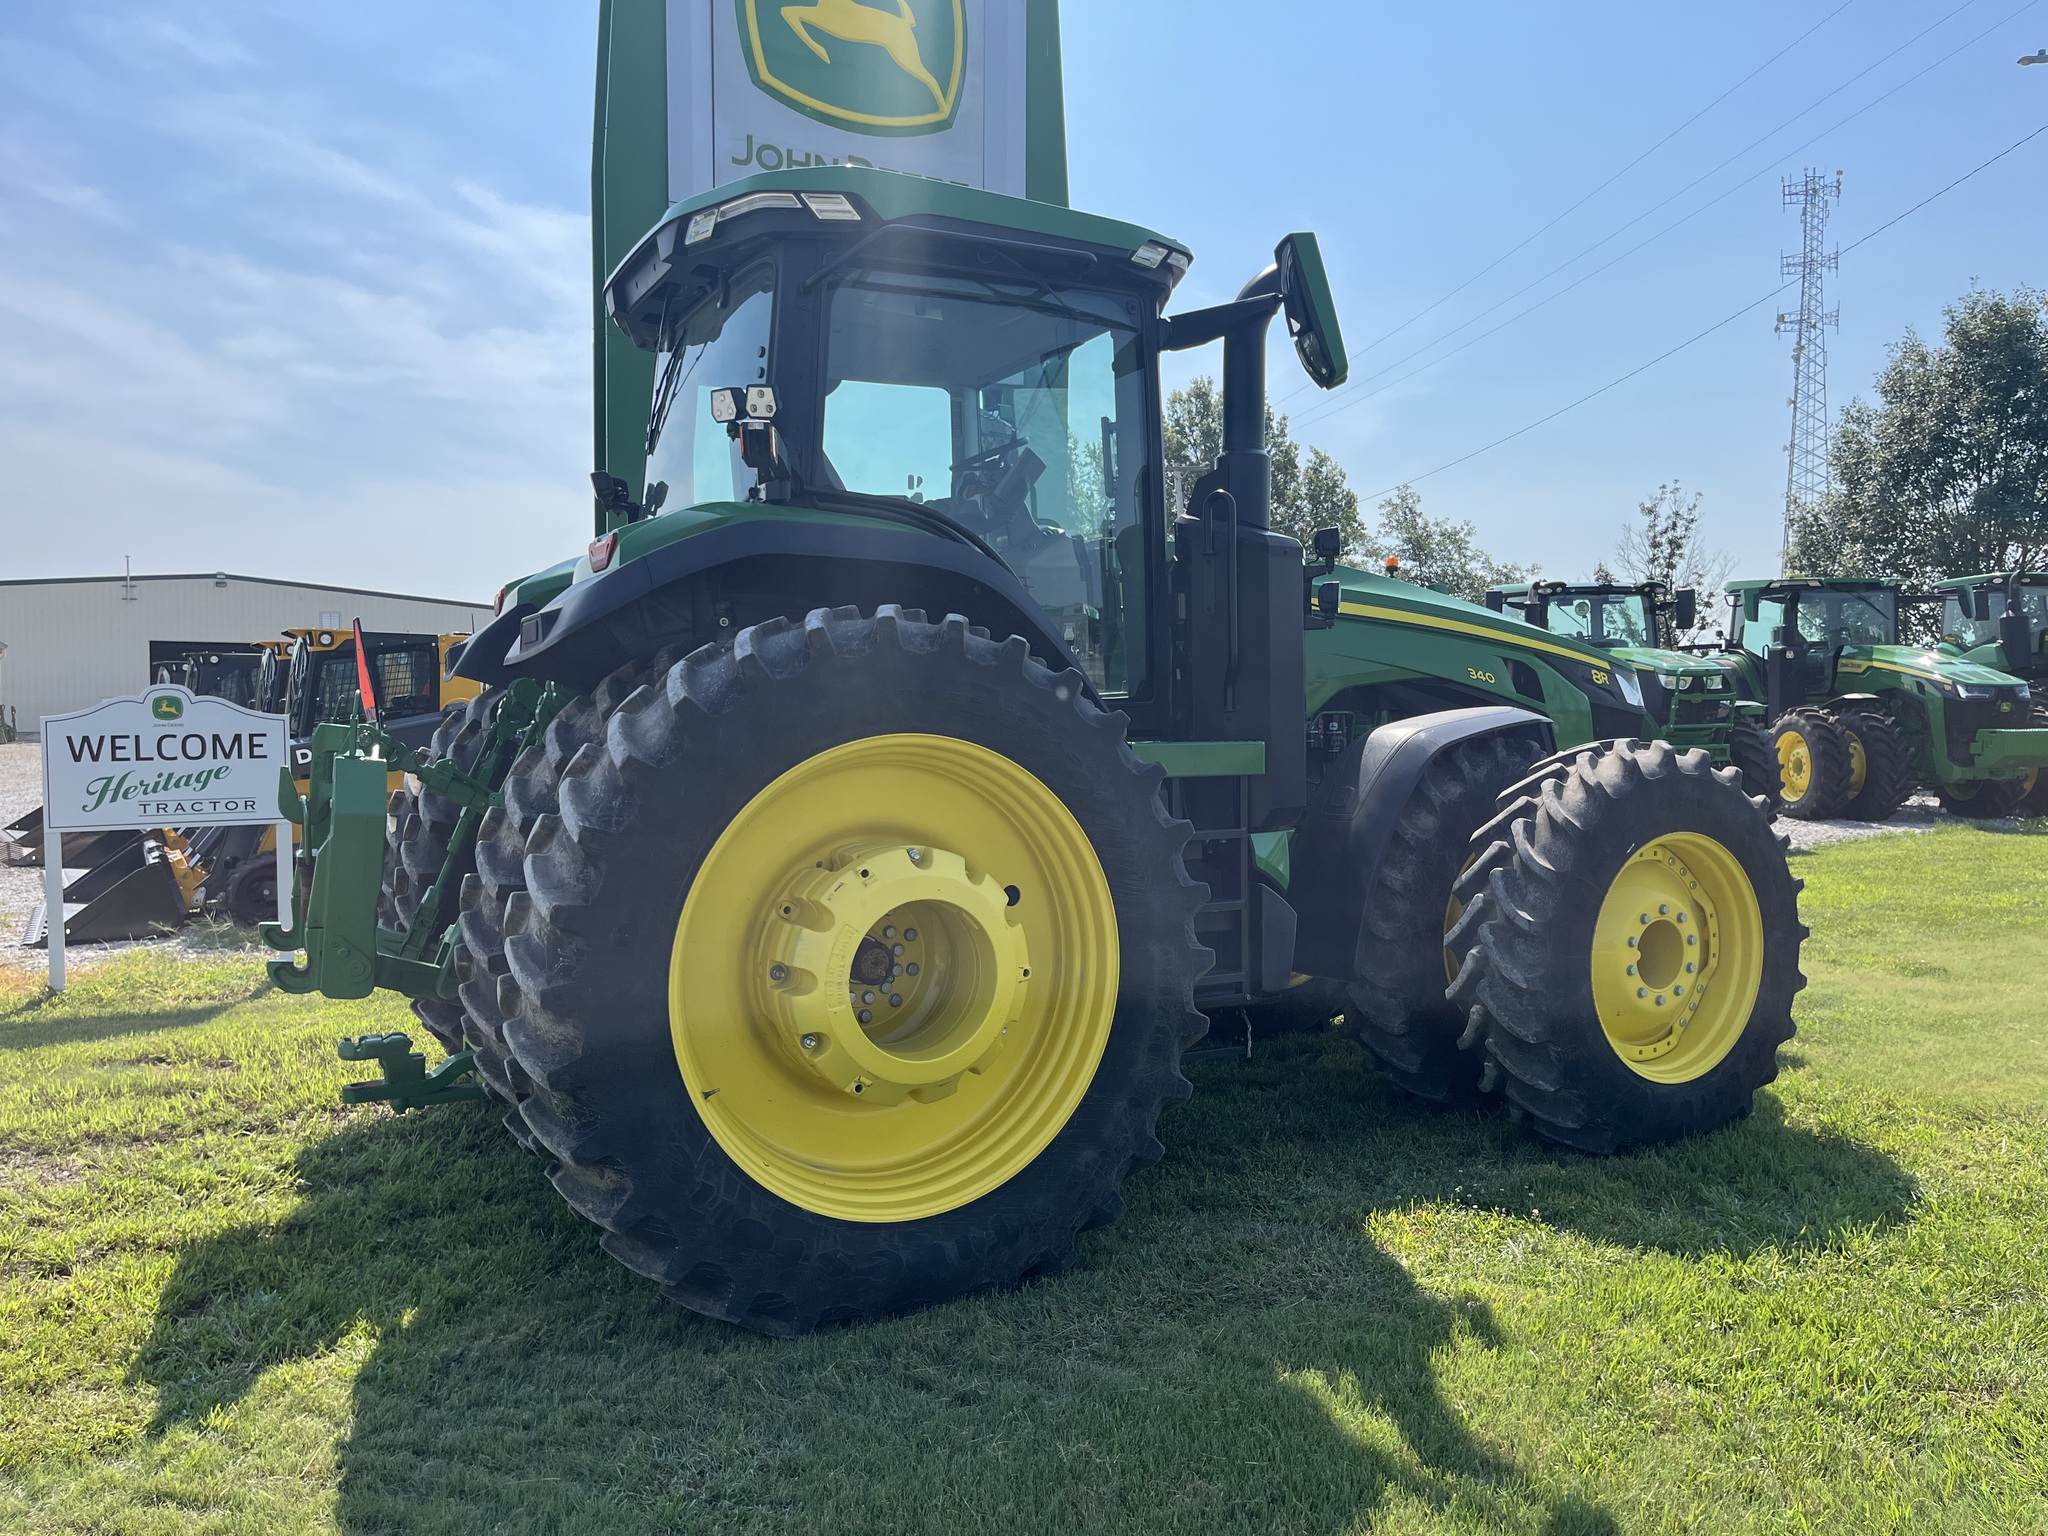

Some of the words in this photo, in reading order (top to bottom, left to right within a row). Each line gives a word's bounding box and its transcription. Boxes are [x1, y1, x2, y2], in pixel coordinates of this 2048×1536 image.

[1467, 667, 1496, 684] 340
[1590, 669, 1610, 685] 8R
[66, 733, 268, 763] WELCOME
[82, 765, 232, 813] Heritage
[138, 800, 257, 815] TRACTOR
